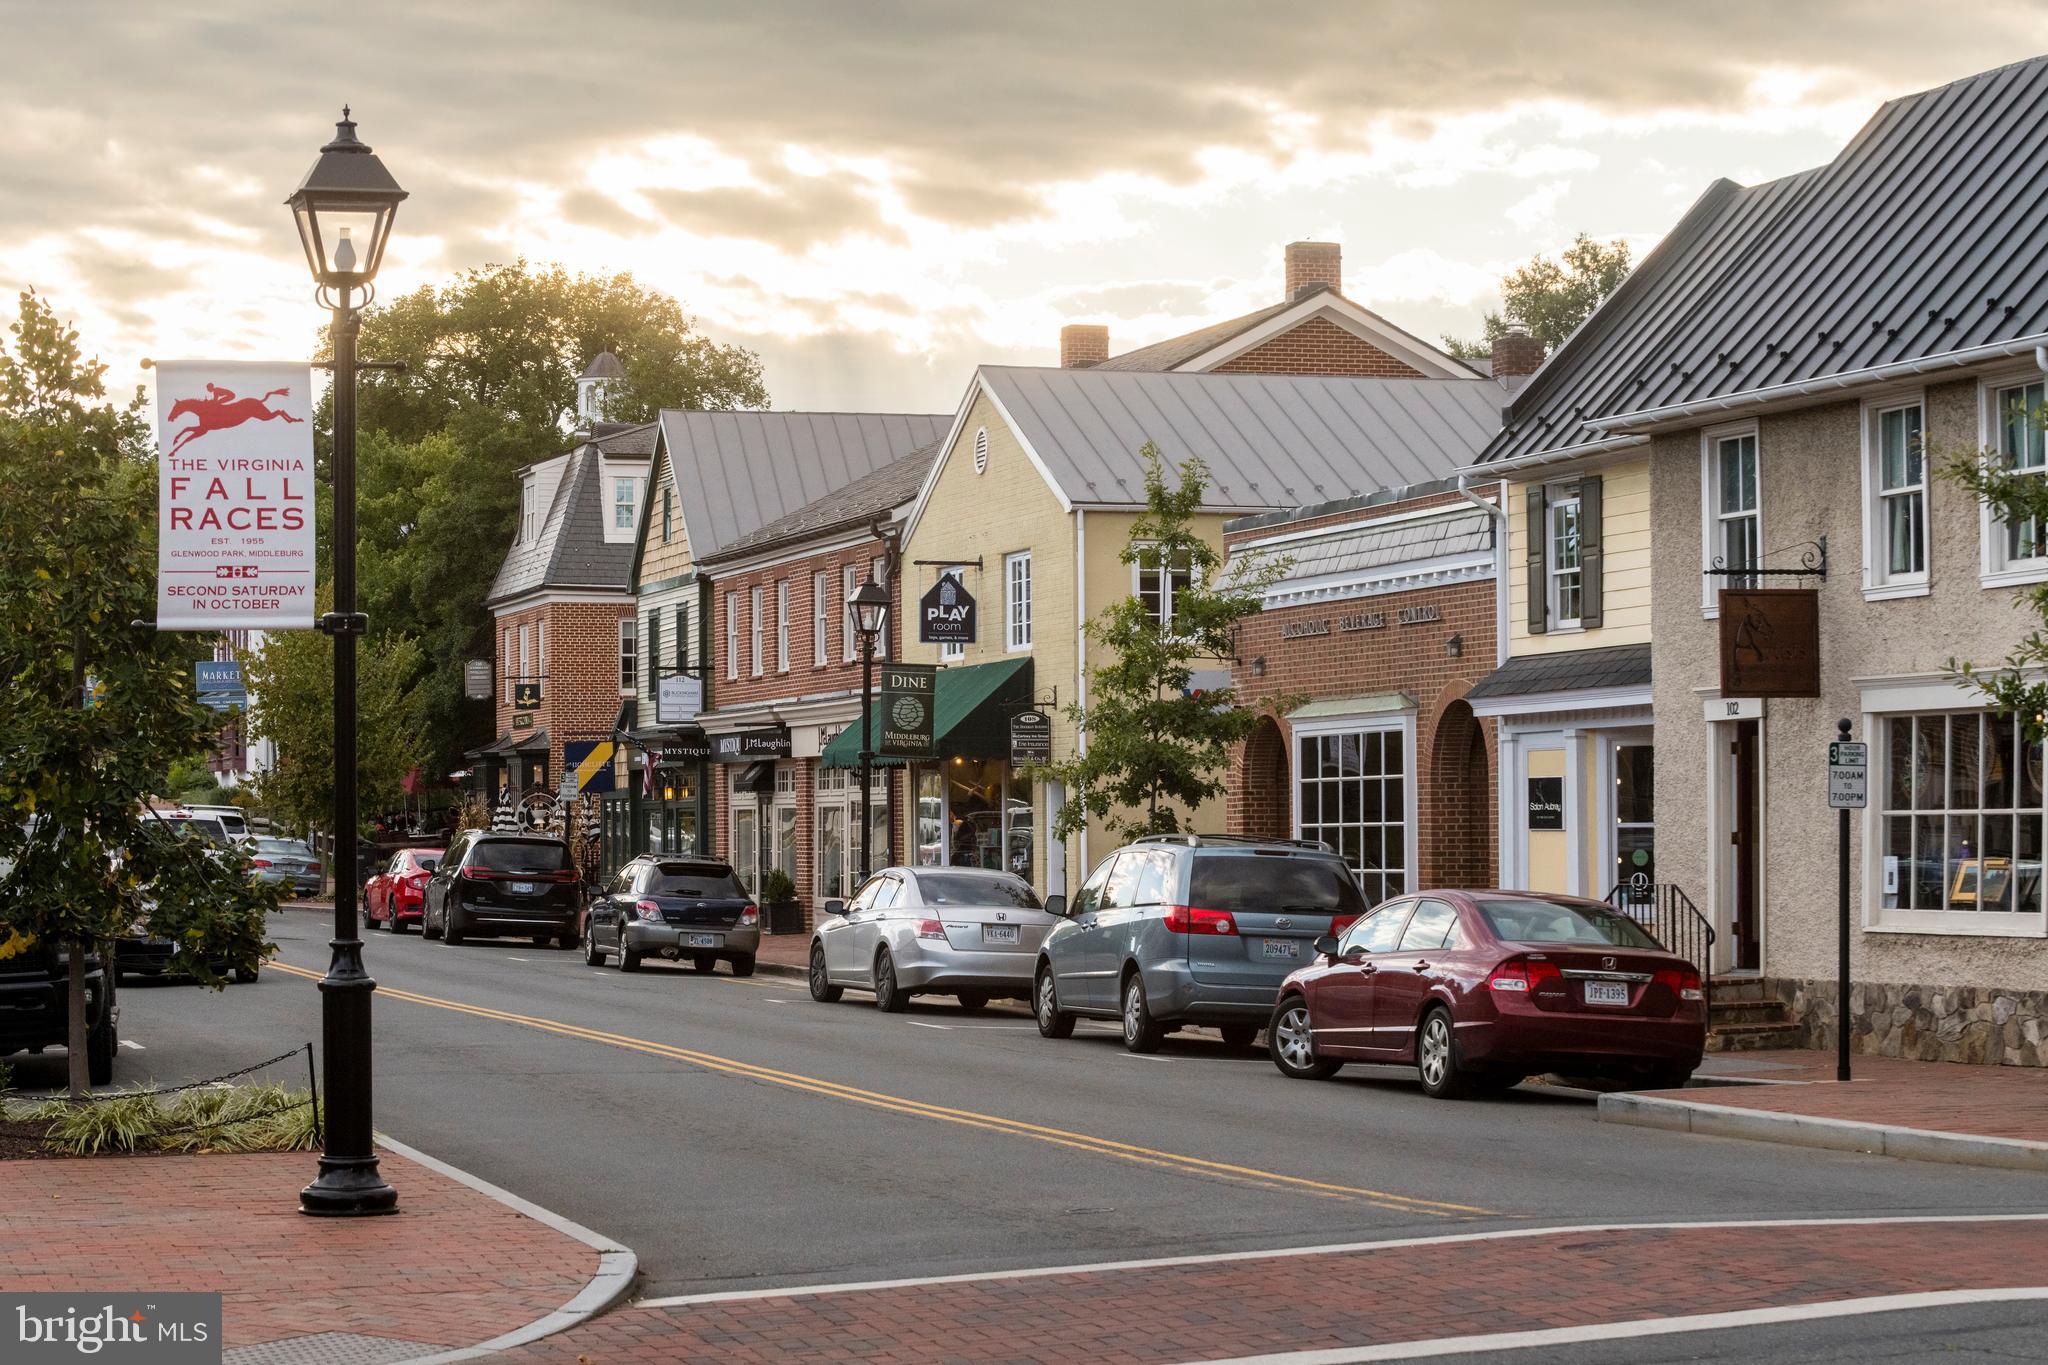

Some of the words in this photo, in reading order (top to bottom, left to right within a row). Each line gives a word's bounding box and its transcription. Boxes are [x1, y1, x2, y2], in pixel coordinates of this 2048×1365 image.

[168, 458, 208, 471] THE
[217, 458, 304, 471] VIRGINIA
[171, 477, 304, 500] FALL
[170, 507, 305, 531] RACES
[211, 537, 232, 545] EST.
[241, 537, 265, 545] 1955
[170, 550, 220, 558] GLENWOOD
[221, 550, 246, 559] PARK,
[248, 550, 304, 558] MIDDLEBURG
[167, 585, 228, 597] SECOND
[231, 585, 306, 597] SATURDAY
[192, 599, 205, 610] IN
[210, 598, 280, 610] OCTOBER
[927, 605, 970, 621] PLAY
[932, 623, 961, 631] room
[1339, 612, 1385, 631] BEVERAGE
[202, 670, 241, 681] MARKET
[892, 674, 928, 689] DINE
[1726, 702, 1740, 716] 102
[884, 731, 930, 741] MIDDLEBURG
[892, 740, 923, 748] VIRGINIA
[1830, 746, 1838, 762] 3
[1842, 782, 1853, 790] TO
